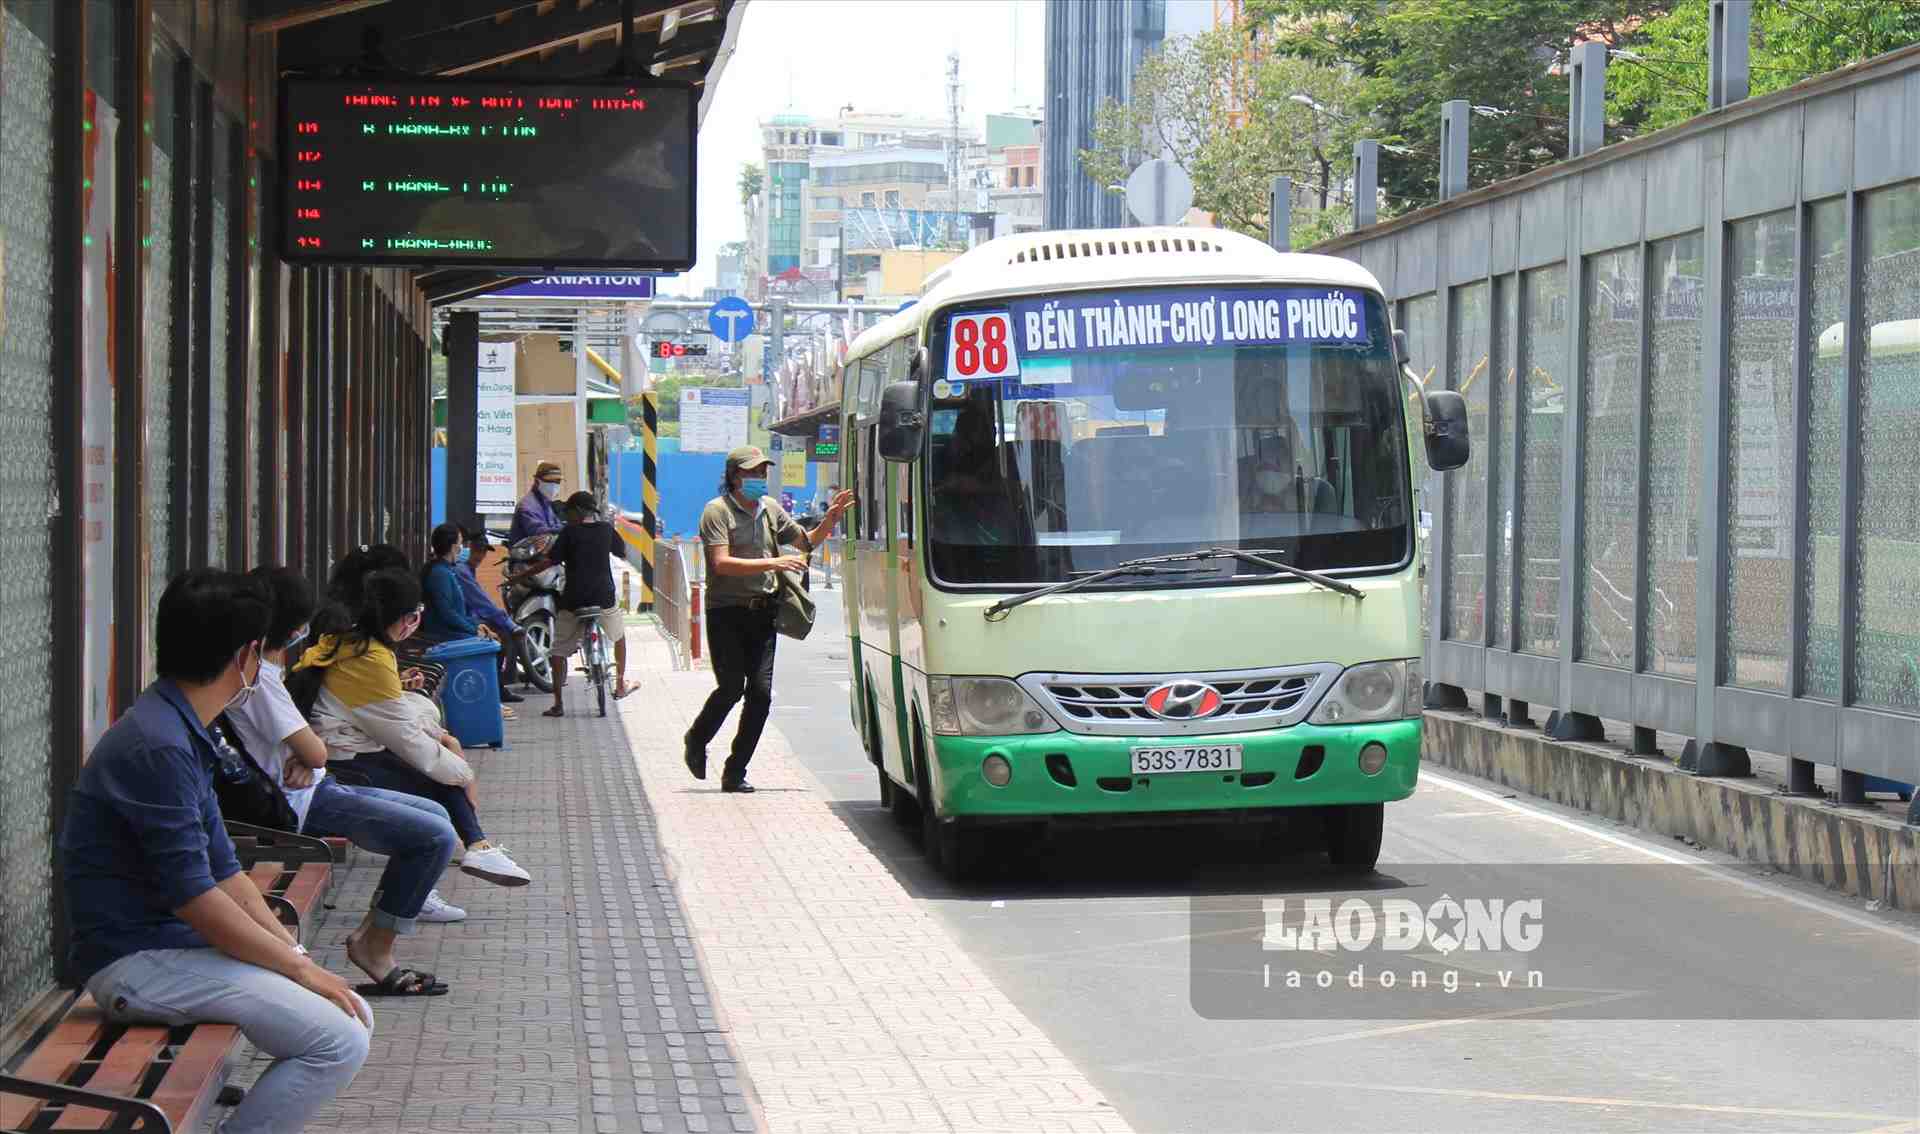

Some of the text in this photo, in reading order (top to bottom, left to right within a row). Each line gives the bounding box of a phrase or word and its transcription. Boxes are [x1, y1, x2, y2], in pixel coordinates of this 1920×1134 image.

[953, 316, 1009, 376] 88
[1025, 293, 1359, 351] BẾN THÀNH-CHỢ LONG PHƯỚC
[1138, 747, 1233, 770] 53S-7831
